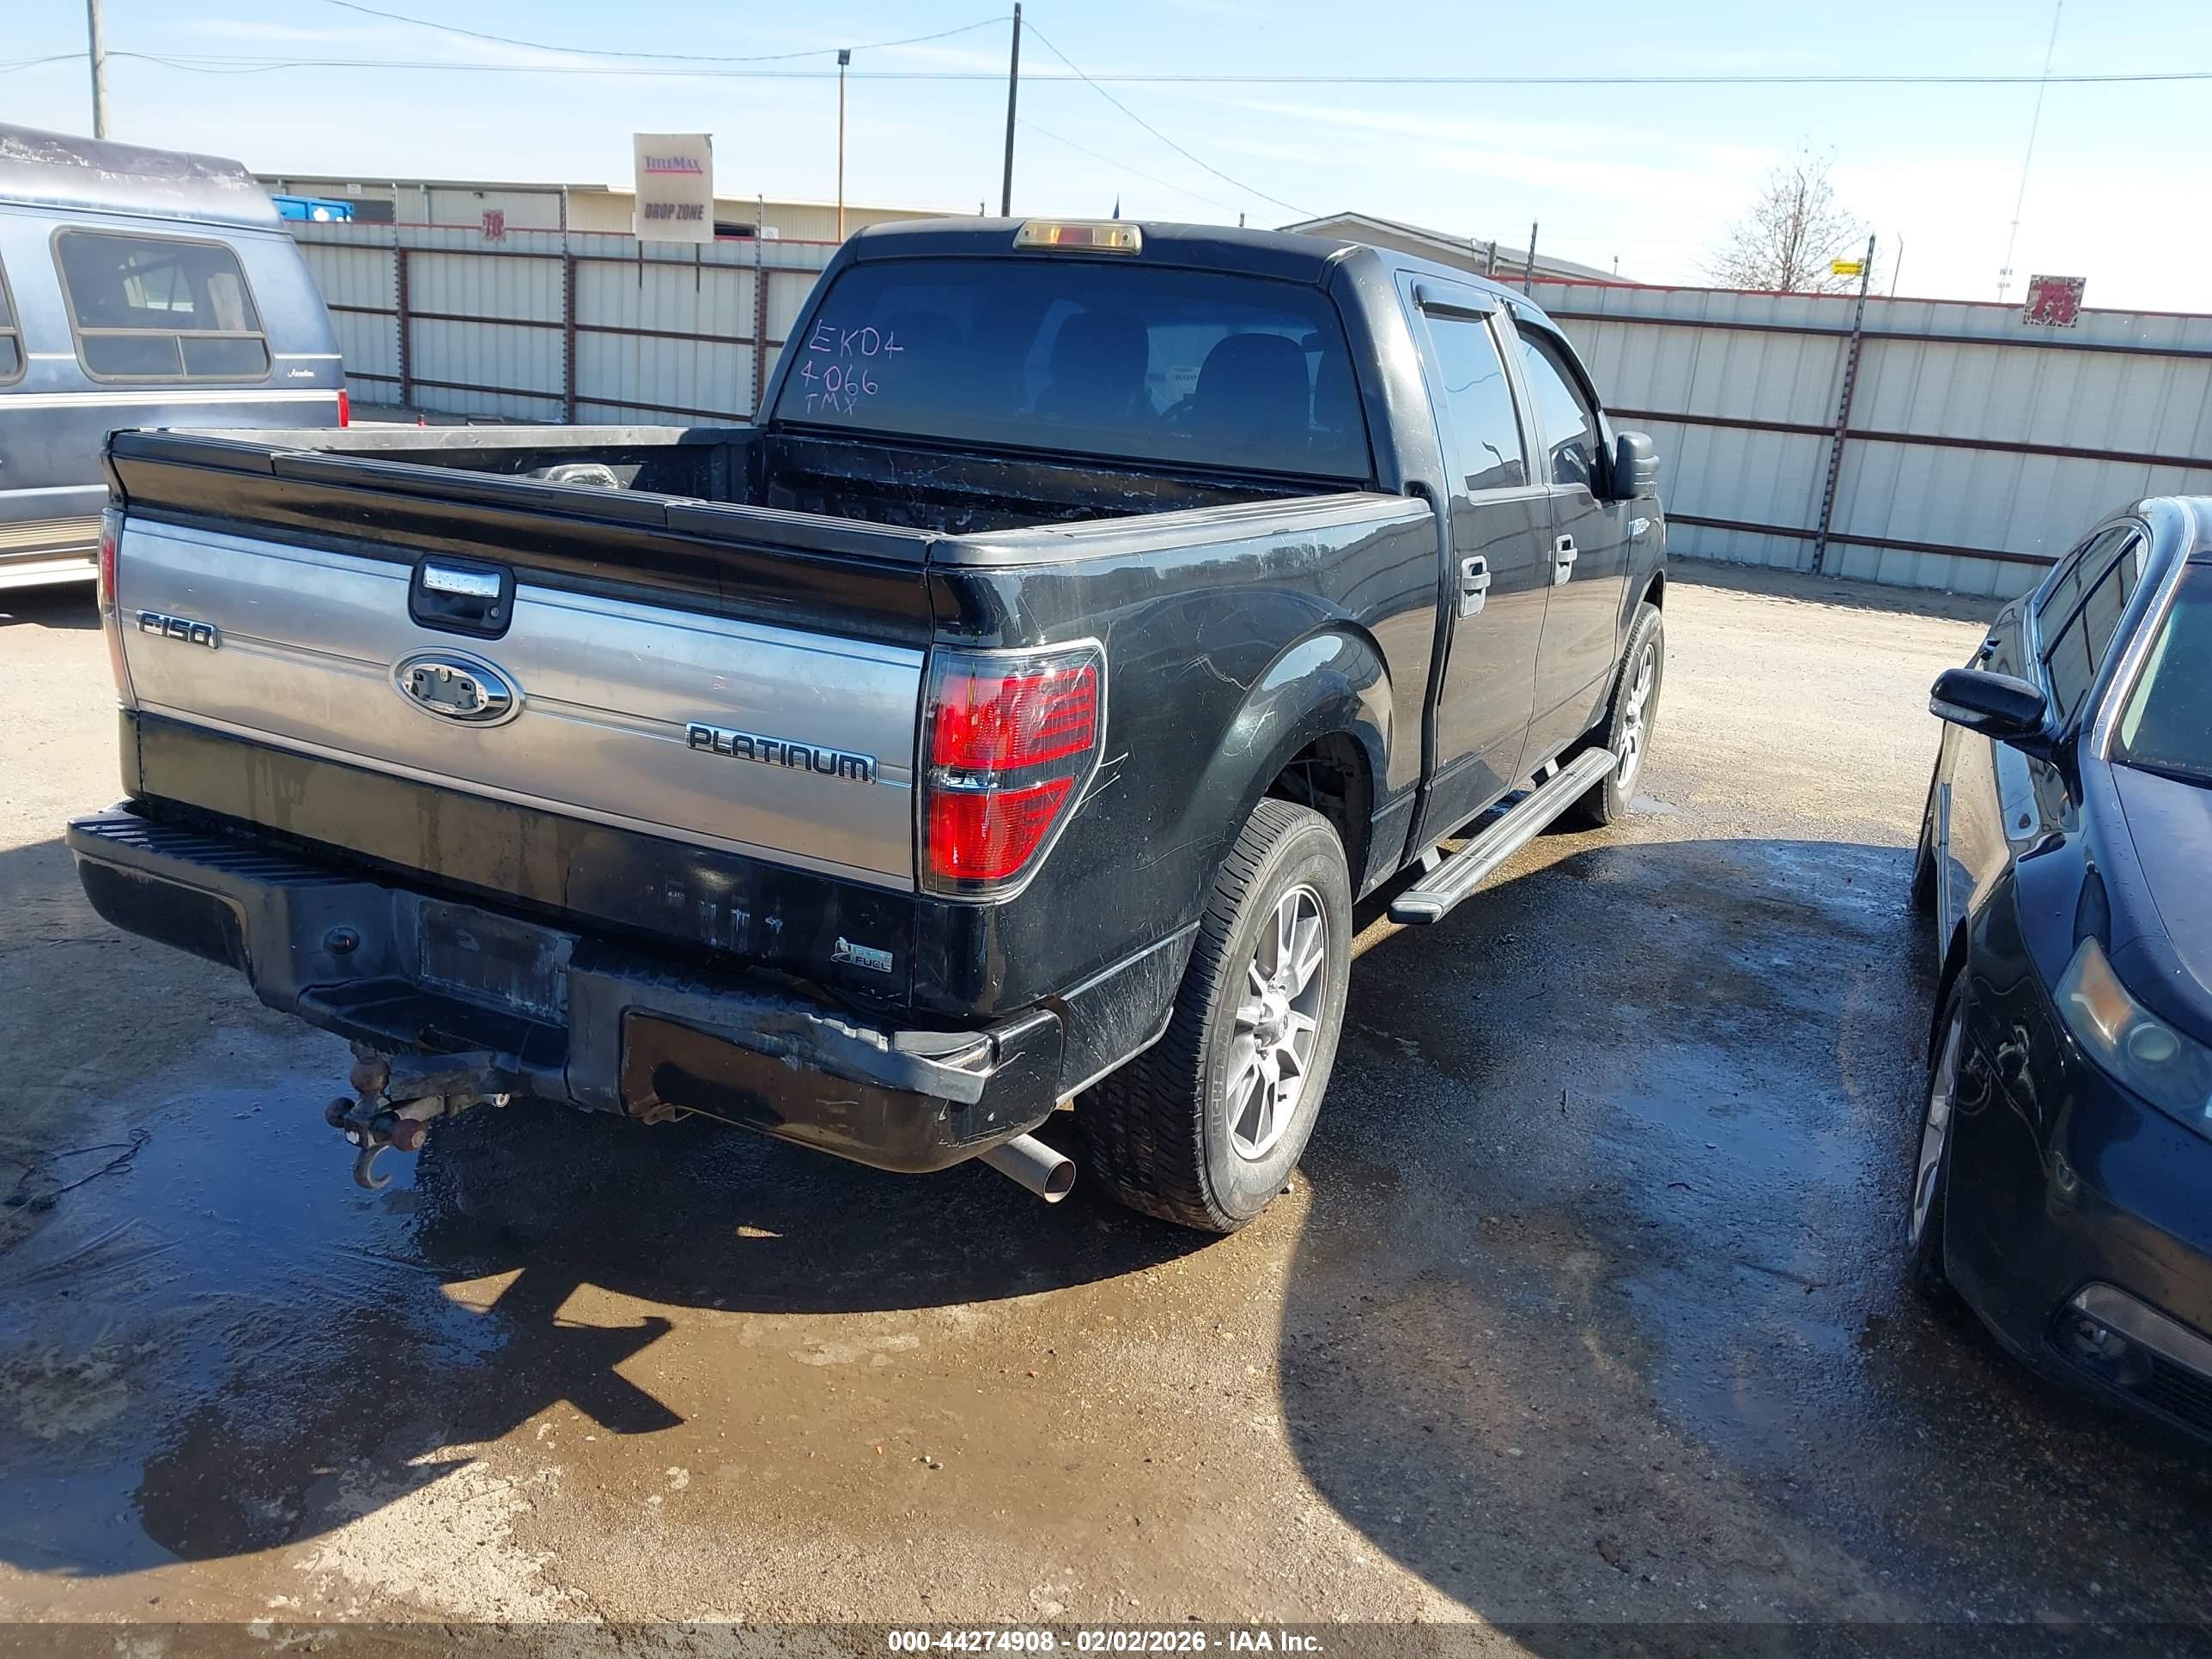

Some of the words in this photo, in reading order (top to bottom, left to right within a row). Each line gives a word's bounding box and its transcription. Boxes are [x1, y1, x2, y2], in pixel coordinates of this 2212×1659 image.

[644, 203, 676, 220] DROP
[676, 204, 705, 221] ZONE
[799, 360, 878, 396] 4066
[805, 392, 858, 416] TMX
[690, 726, 869, 782] PLATINUM
[854, 955, 890, 971] FUEL
